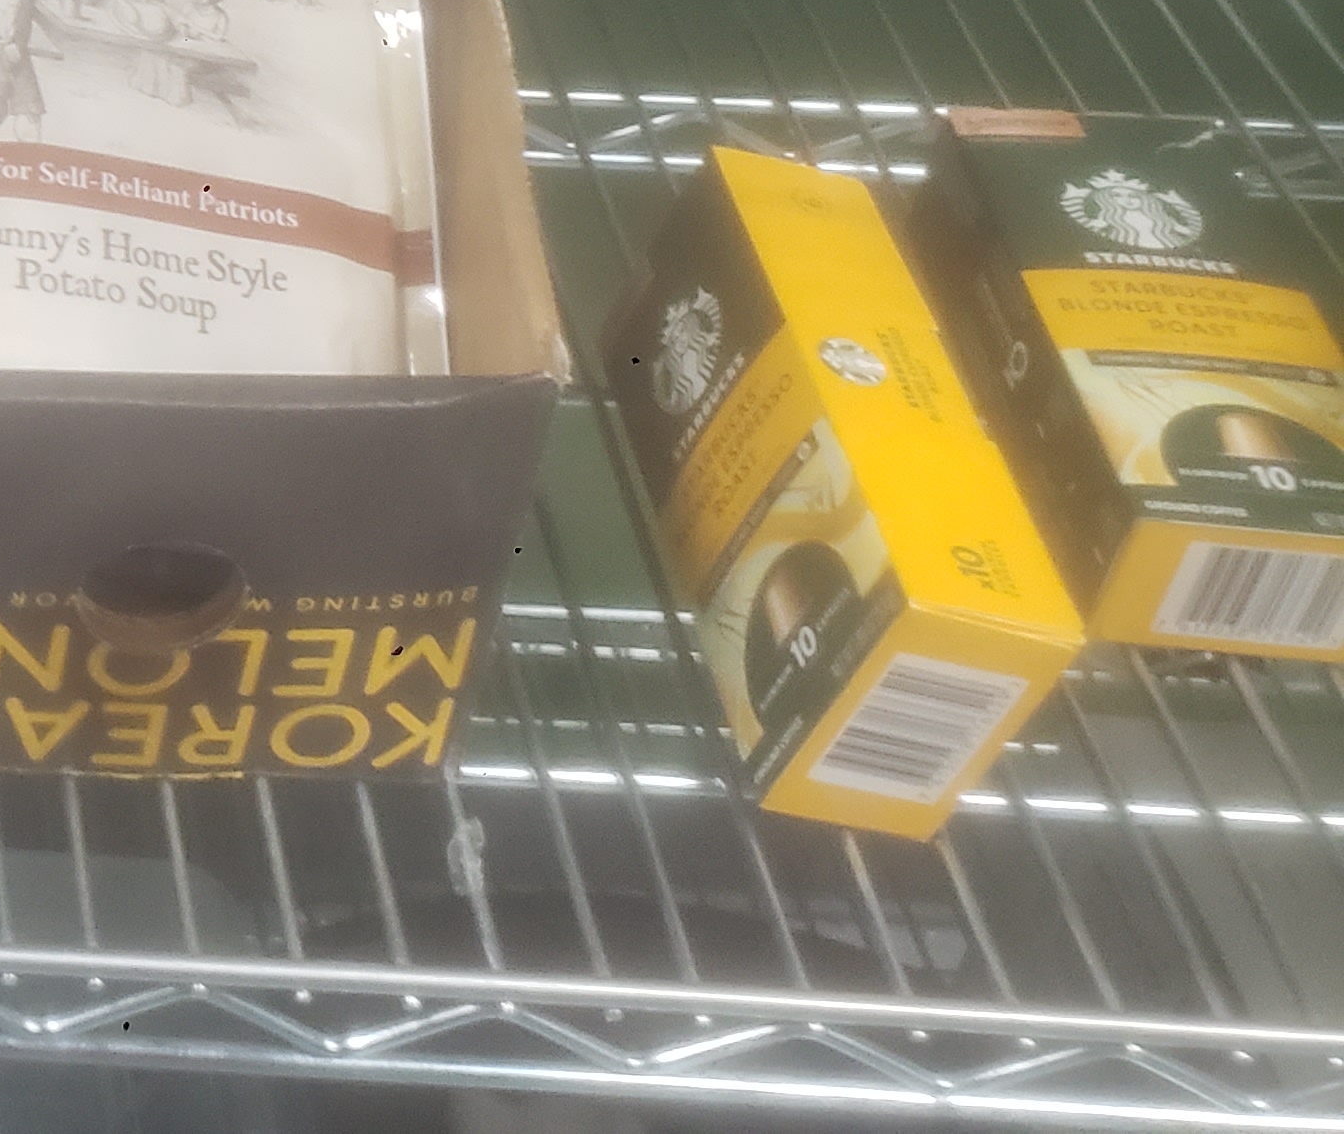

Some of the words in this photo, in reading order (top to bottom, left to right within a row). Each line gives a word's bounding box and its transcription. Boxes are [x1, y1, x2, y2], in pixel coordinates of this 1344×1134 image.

[38, 162, 191, 212] Self-Reliant
[198, 190, 299, 230] Patriots
[102, 229, 201, 280] Home
[207, 249, 289, 295] Style
[1083, 251, 1238, 275] STARBUCKS
[14, 257, 127, 307] Potato
[137, 276, 218, 335] Soup
[1150, 319, 1239, 337] ROAST
[1248, 465, 1298, 492] 10
[295, 584, 480, 612] BURSTING
[789, 625, 817, 669] 10
